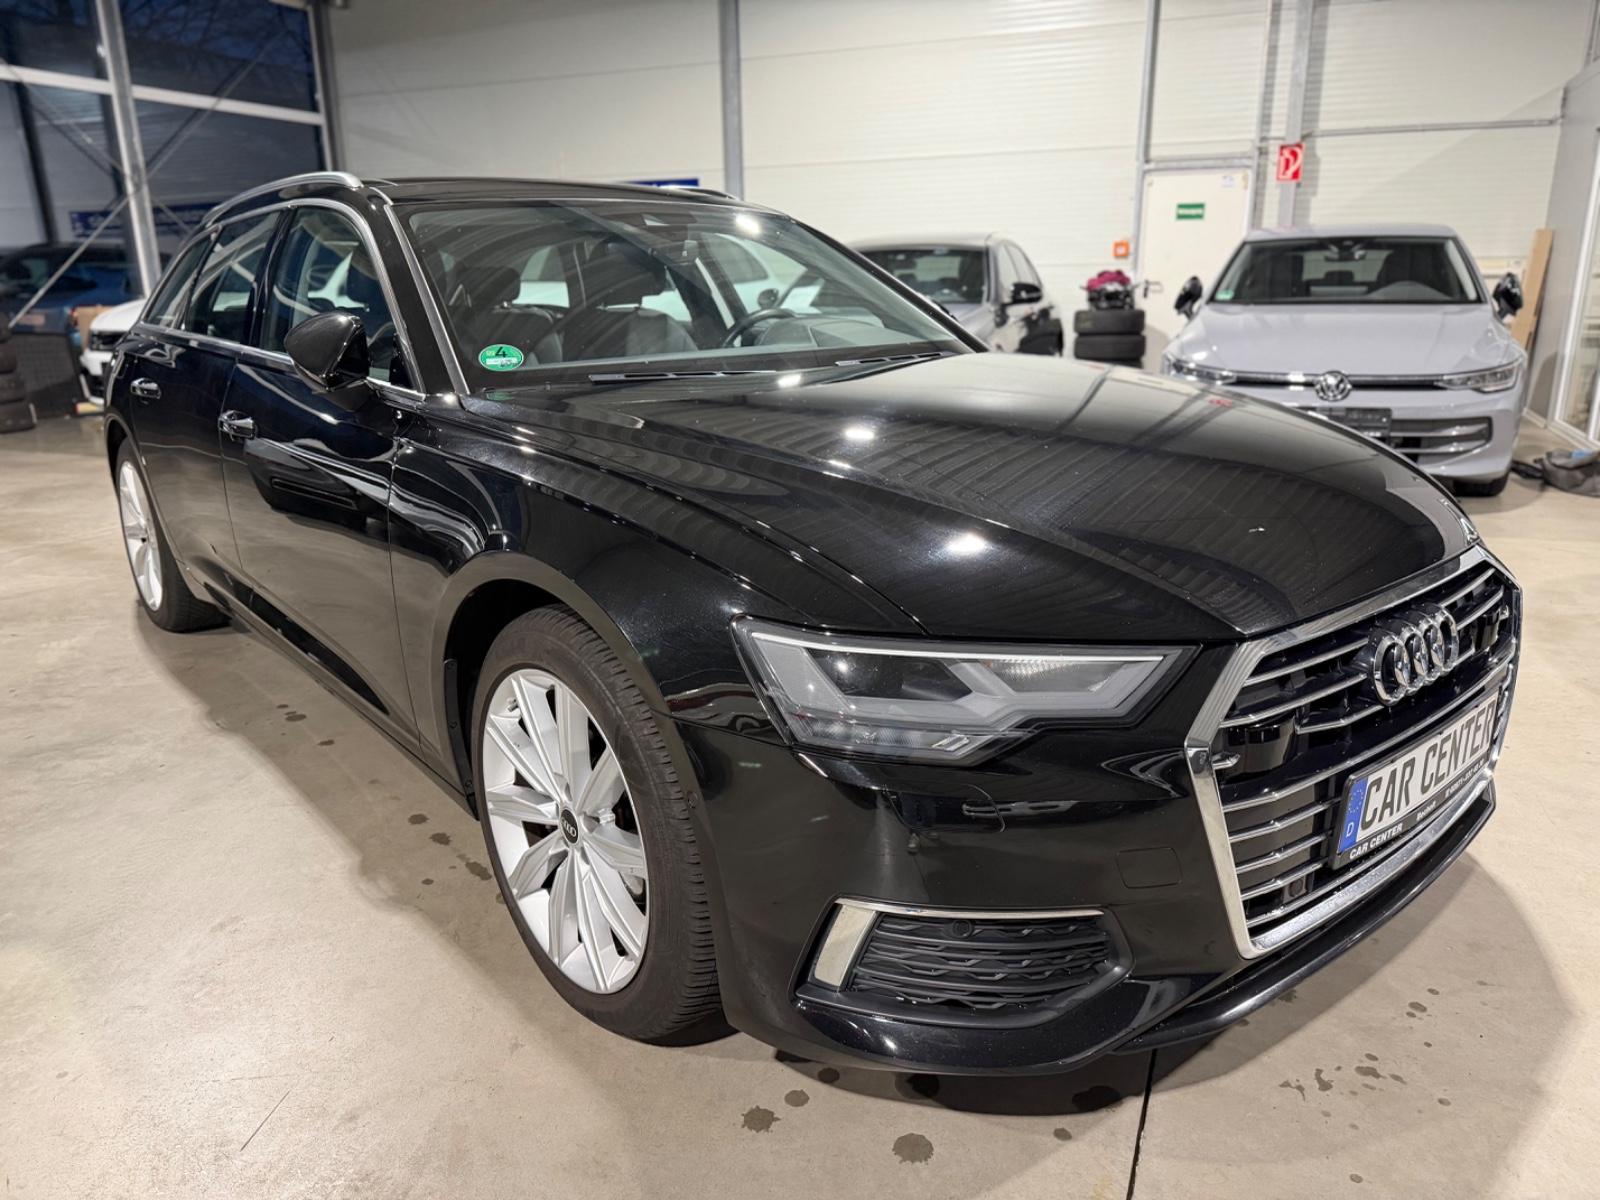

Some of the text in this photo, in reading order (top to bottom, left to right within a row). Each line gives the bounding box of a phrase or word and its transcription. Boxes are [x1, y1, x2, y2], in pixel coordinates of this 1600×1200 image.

[495, 346, 508, 358] 4
[1361, 756, 1416, 831] CAR
[1420, 699, 1497, 796] CENTER
[1346, 822, 1355, 838] D
[1349, 823, 1403, 859] CAR CENTER
